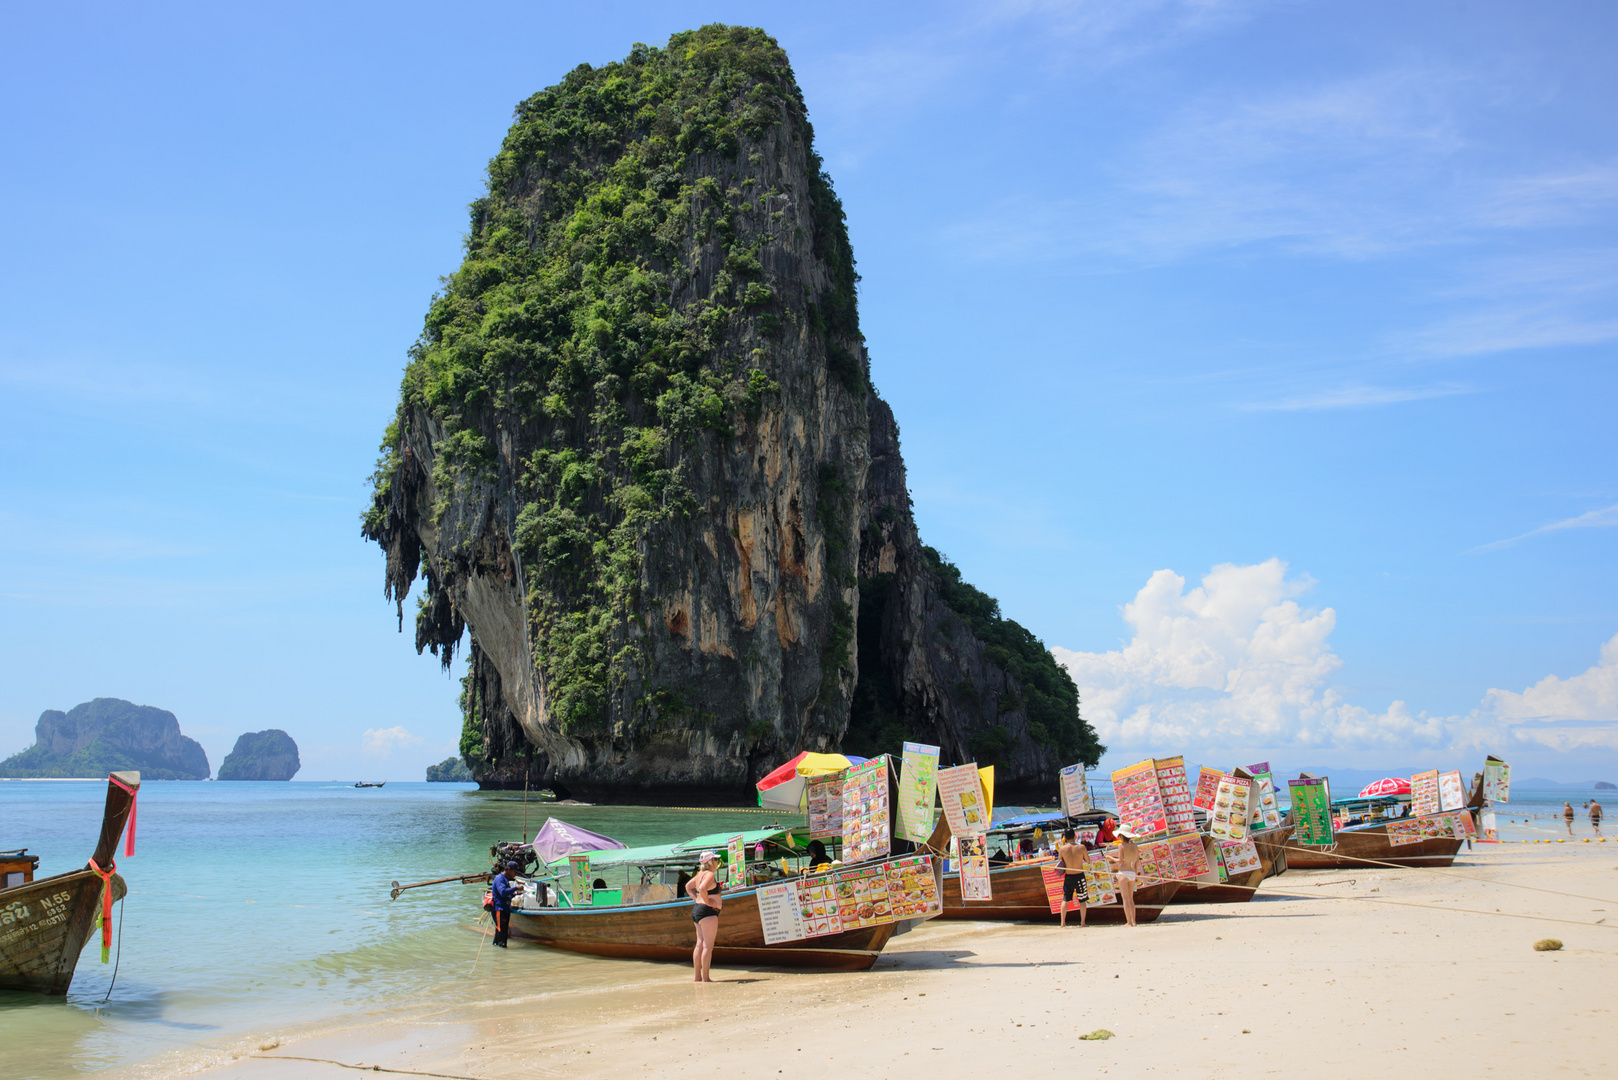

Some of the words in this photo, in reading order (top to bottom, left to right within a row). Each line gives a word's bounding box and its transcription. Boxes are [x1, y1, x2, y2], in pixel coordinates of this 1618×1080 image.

[849, 765, 862, 774] THAI
[863, 758, 880, 769] FOOD
[840, 872, 861, 882] SPECIAL
[40, 891, 70, 910] N.55
